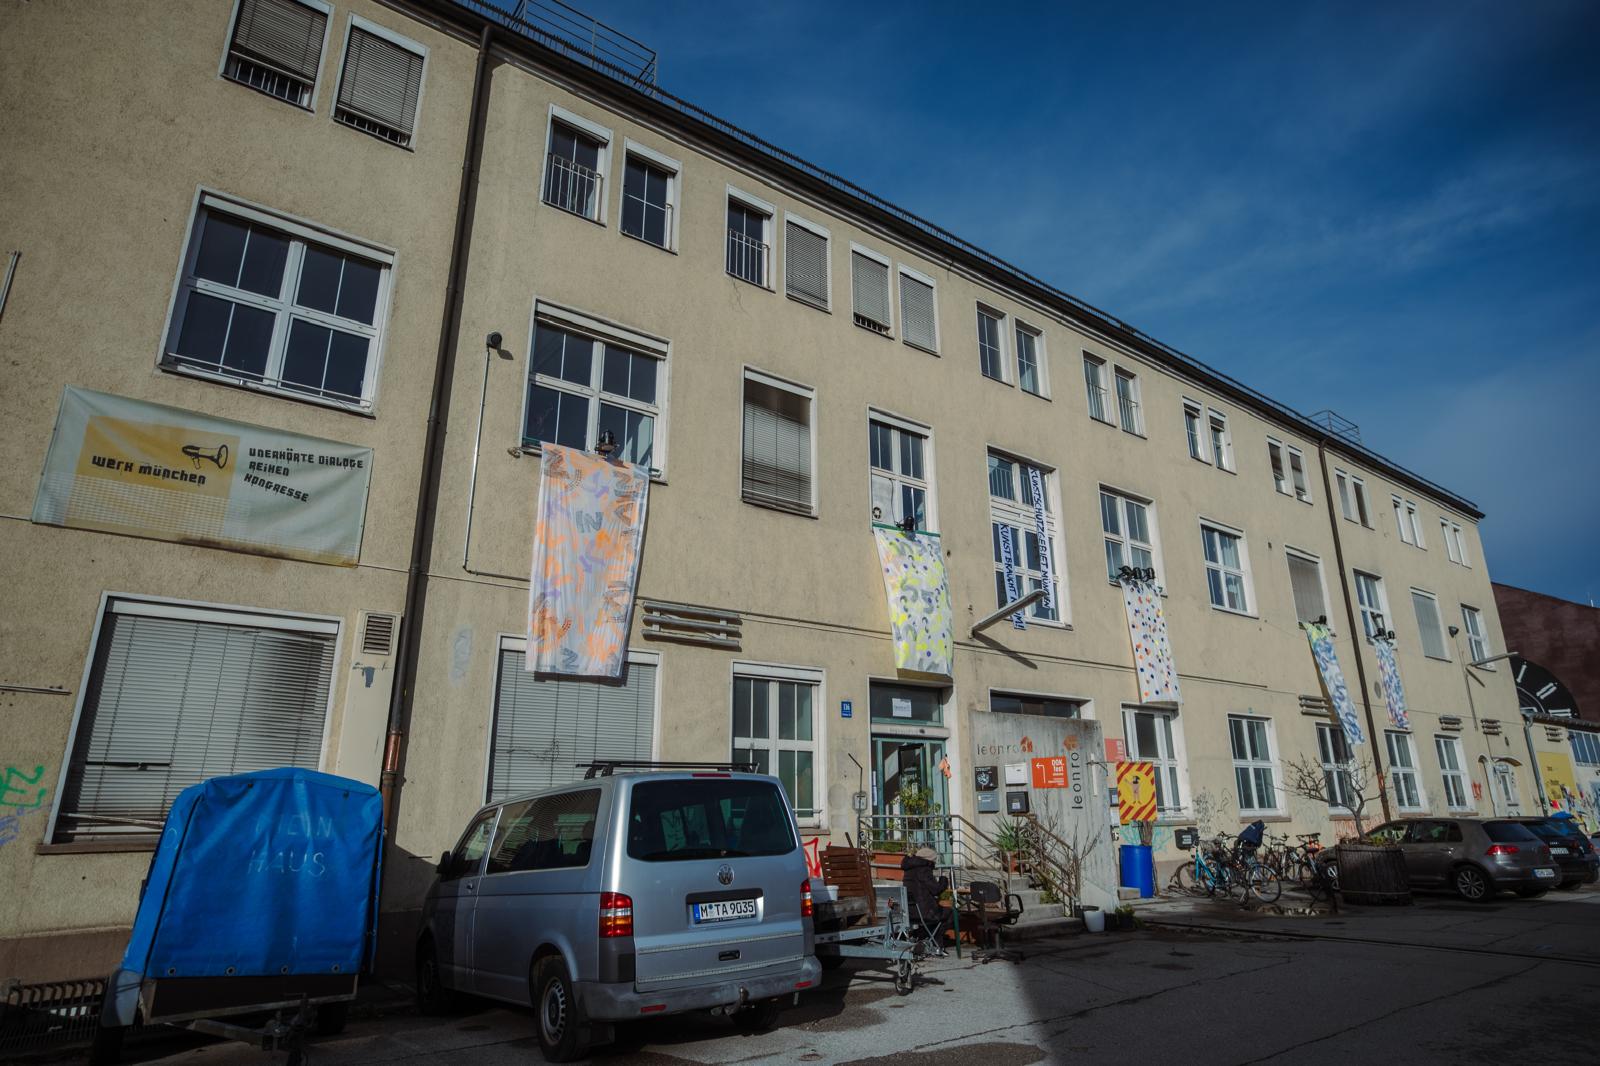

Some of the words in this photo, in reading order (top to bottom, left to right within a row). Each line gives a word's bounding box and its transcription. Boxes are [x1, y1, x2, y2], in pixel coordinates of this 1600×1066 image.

[138, 464, 206, 485] münchen
[1000, 523, 1012, 556] KUNST
[247, 849, 326, 877] HAUS
[700, 906, 708, 918] M
[714, 903, 729, 916] TA
[729, 901, 754, 915] 9035
